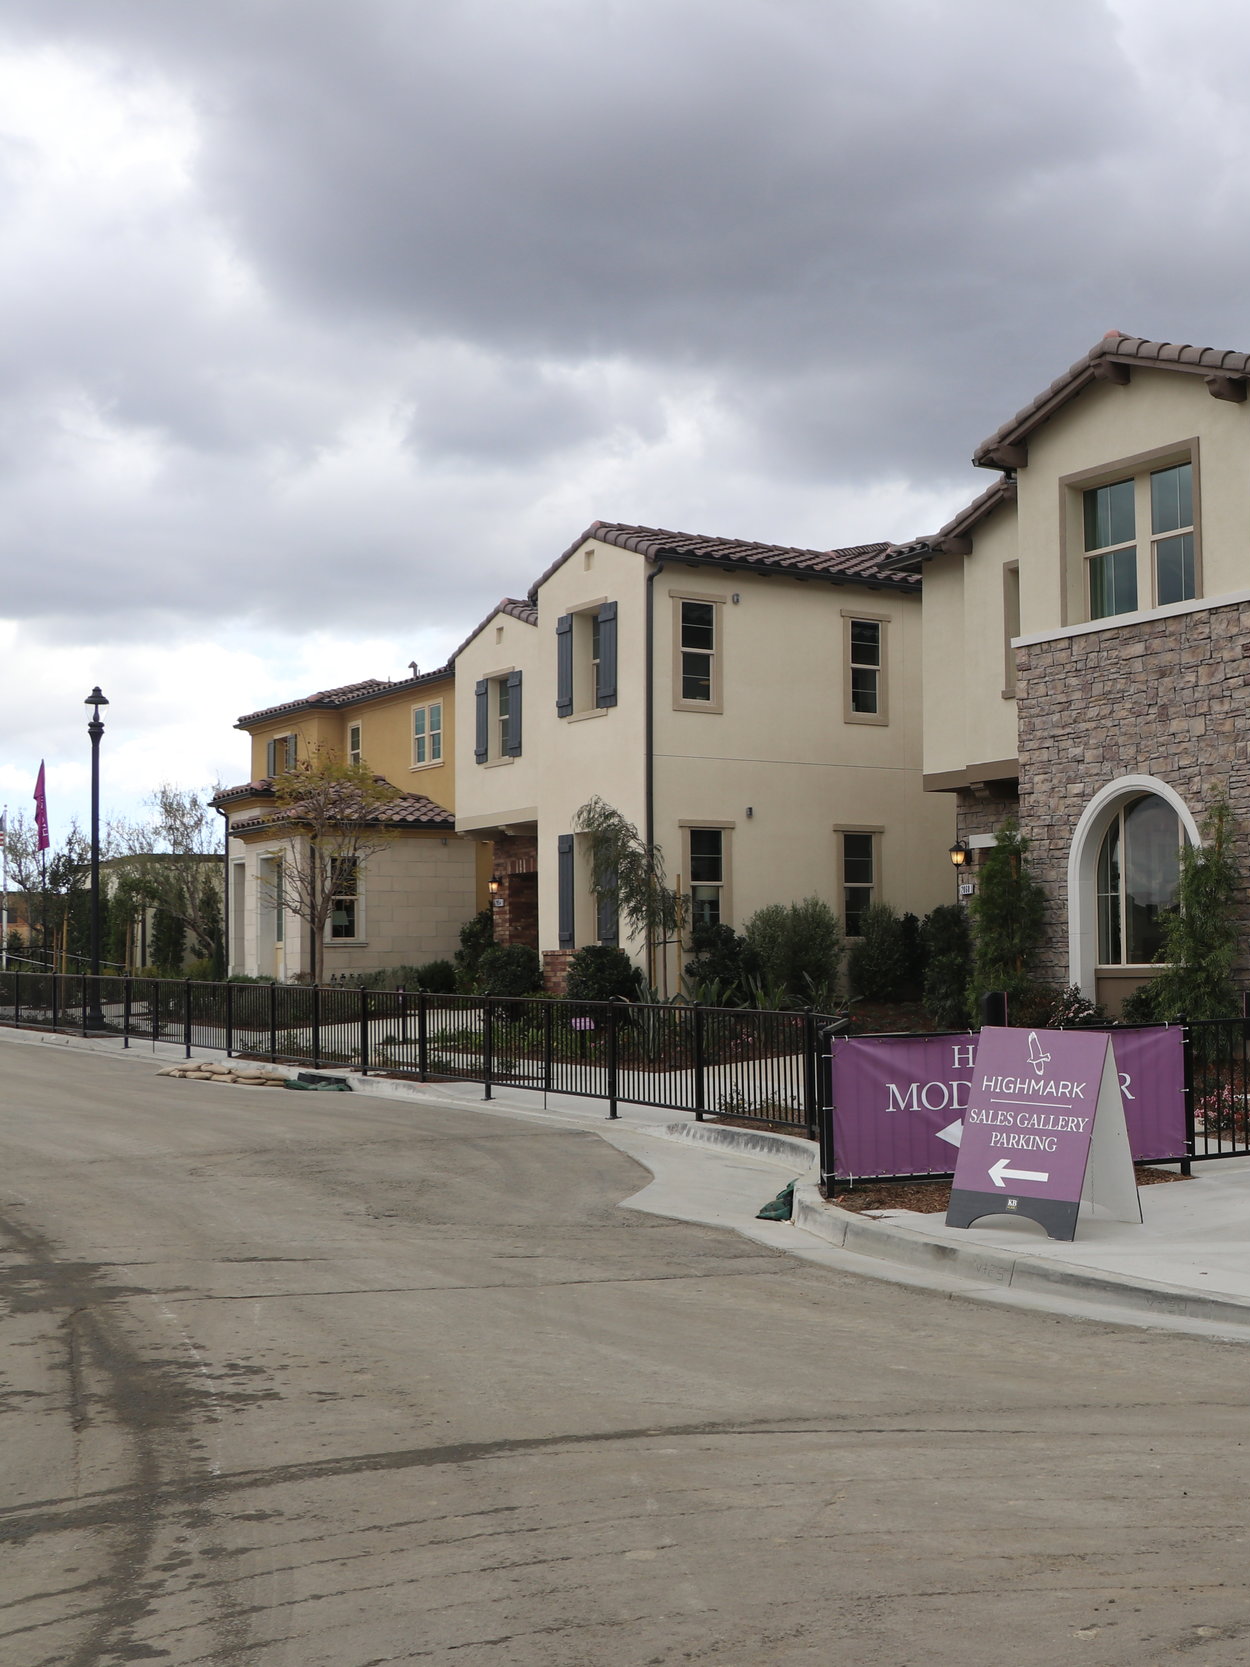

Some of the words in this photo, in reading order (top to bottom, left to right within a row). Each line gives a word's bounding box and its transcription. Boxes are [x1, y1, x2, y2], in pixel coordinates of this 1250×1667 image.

[885, 1081, 972, 1112] MOD
[982, 1075, 1086, 1099] HIGHMARK
[969, 1108, 1014, 1126] SALES
[1016, 1112, 1089, 1132] GALLERY
[989, 1131, 1057, 1152] PARKING
